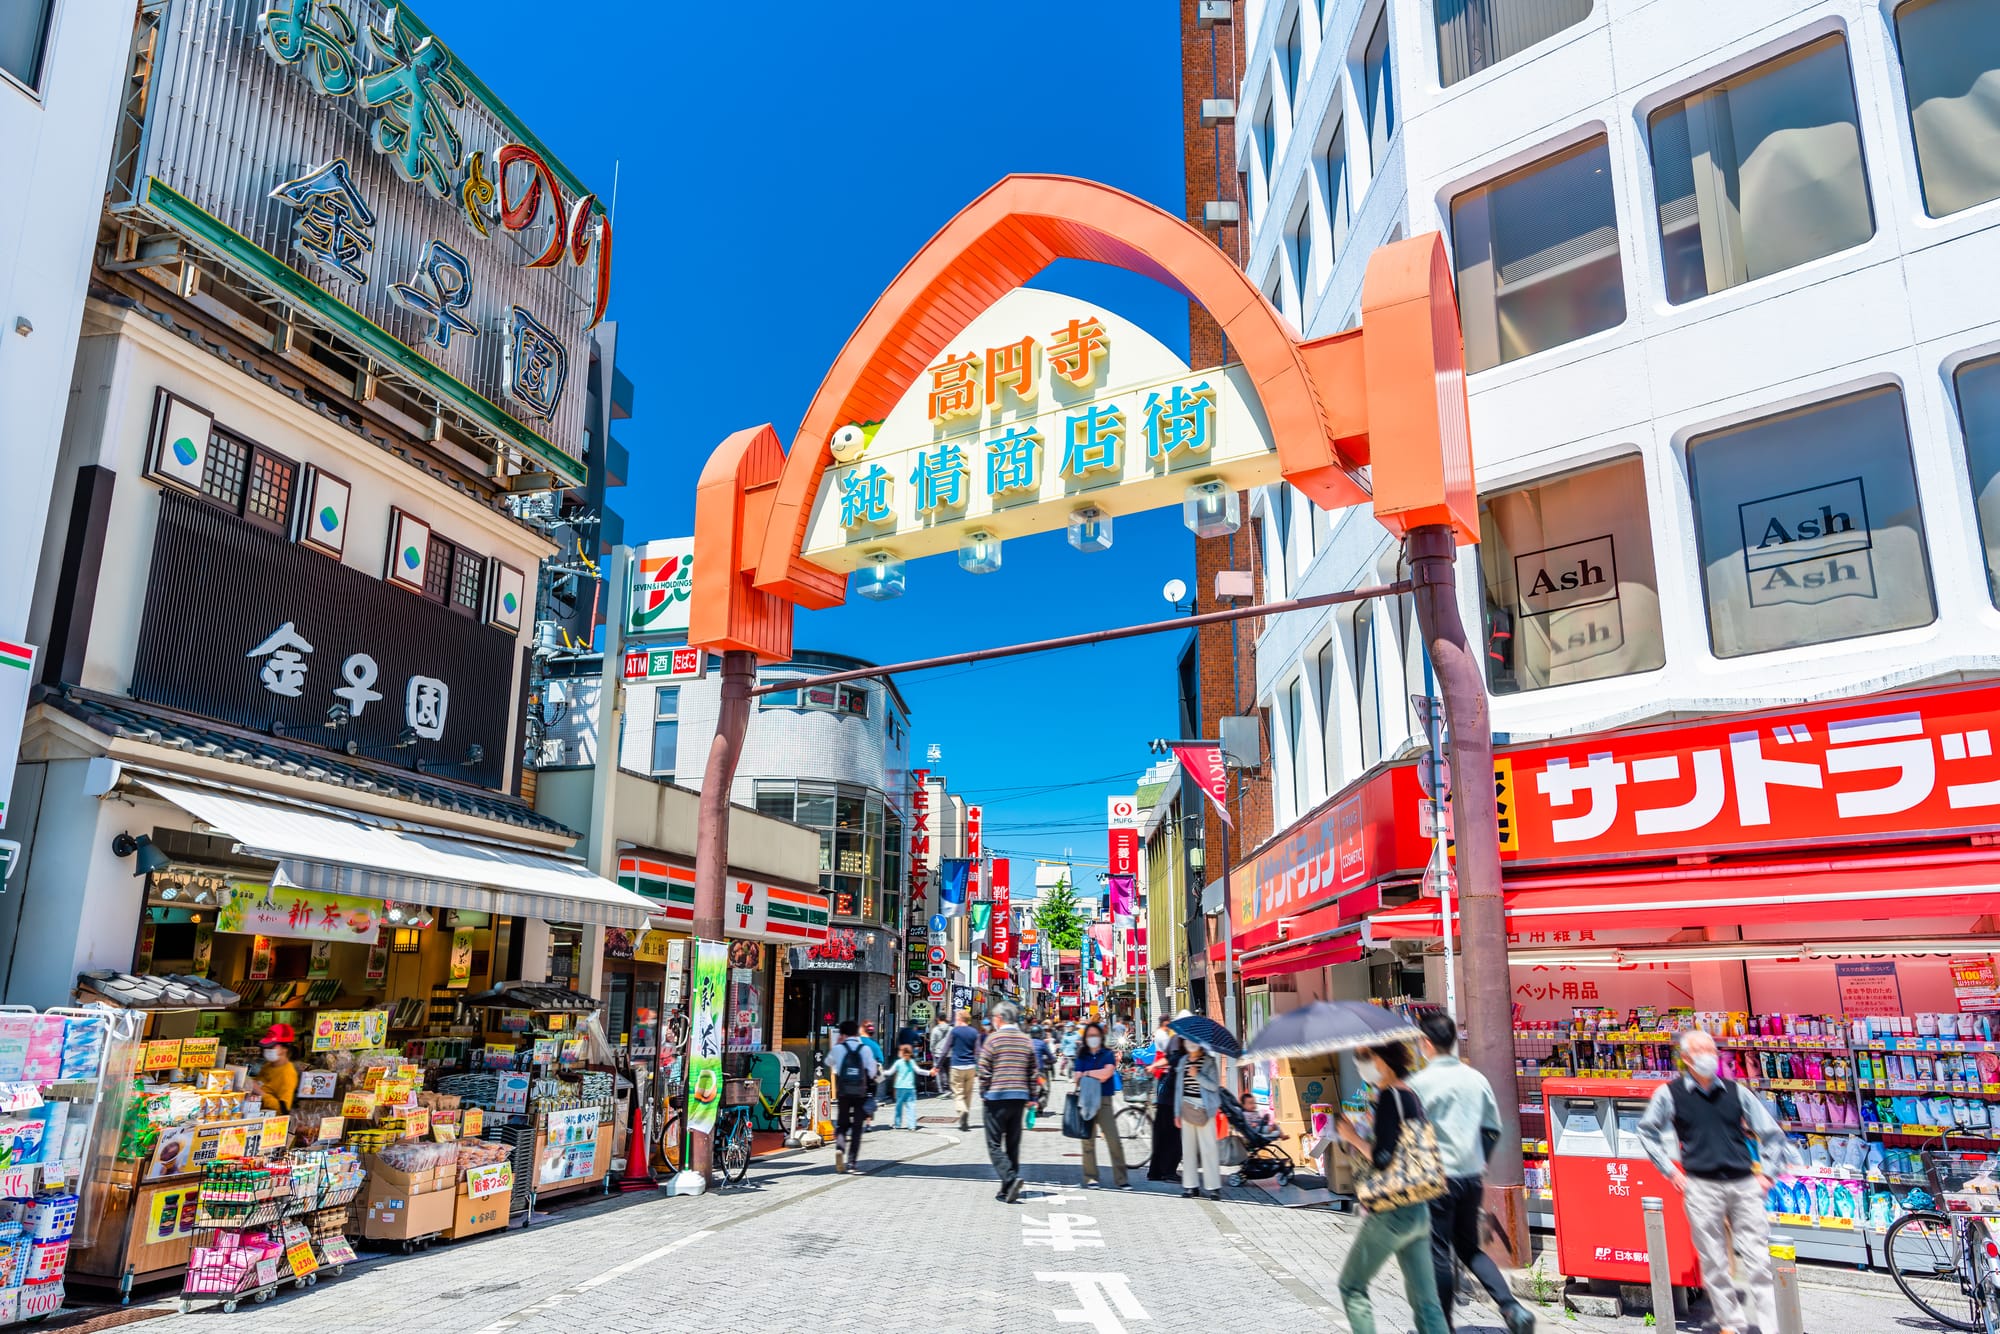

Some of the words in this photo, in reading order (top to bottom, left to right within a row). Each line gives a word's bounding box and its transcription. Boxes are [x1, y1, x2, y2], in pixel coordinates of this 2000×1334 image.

[927, 316, 1106, 421] 高円寺
[839, 381, 1212, 529] 純情商店街
[1756, 504, 1856, 549] Ash
[1527, 557, 1606, 598] Ash
[626, 656, 648, 675] ATM
[652, 655, 669, 673] 酒
[673, 653, 697, 671] たばこ
[1206, 747, 1226, 795] TOKYO
[1342, 814, 1358, 830] DRUG
[1117, 835, 1130, 874] 三菱U
[1262, 815, 1335, 912] サンドラッグ
[1342, 847, 1362, 868] COSMETIC
[288, 898, 341, 933] 新茶
[931, 982, 942, 992] 20
[1516, 981, 1599, 1000] ペット用品
[1606, 1163, 1629, 1175] 郵便
[474, 1175, 508, 1194] 新茶フェア
[1608, 1184, 1630, 1196] POST
[27, 1292, 57, 1315] 400
